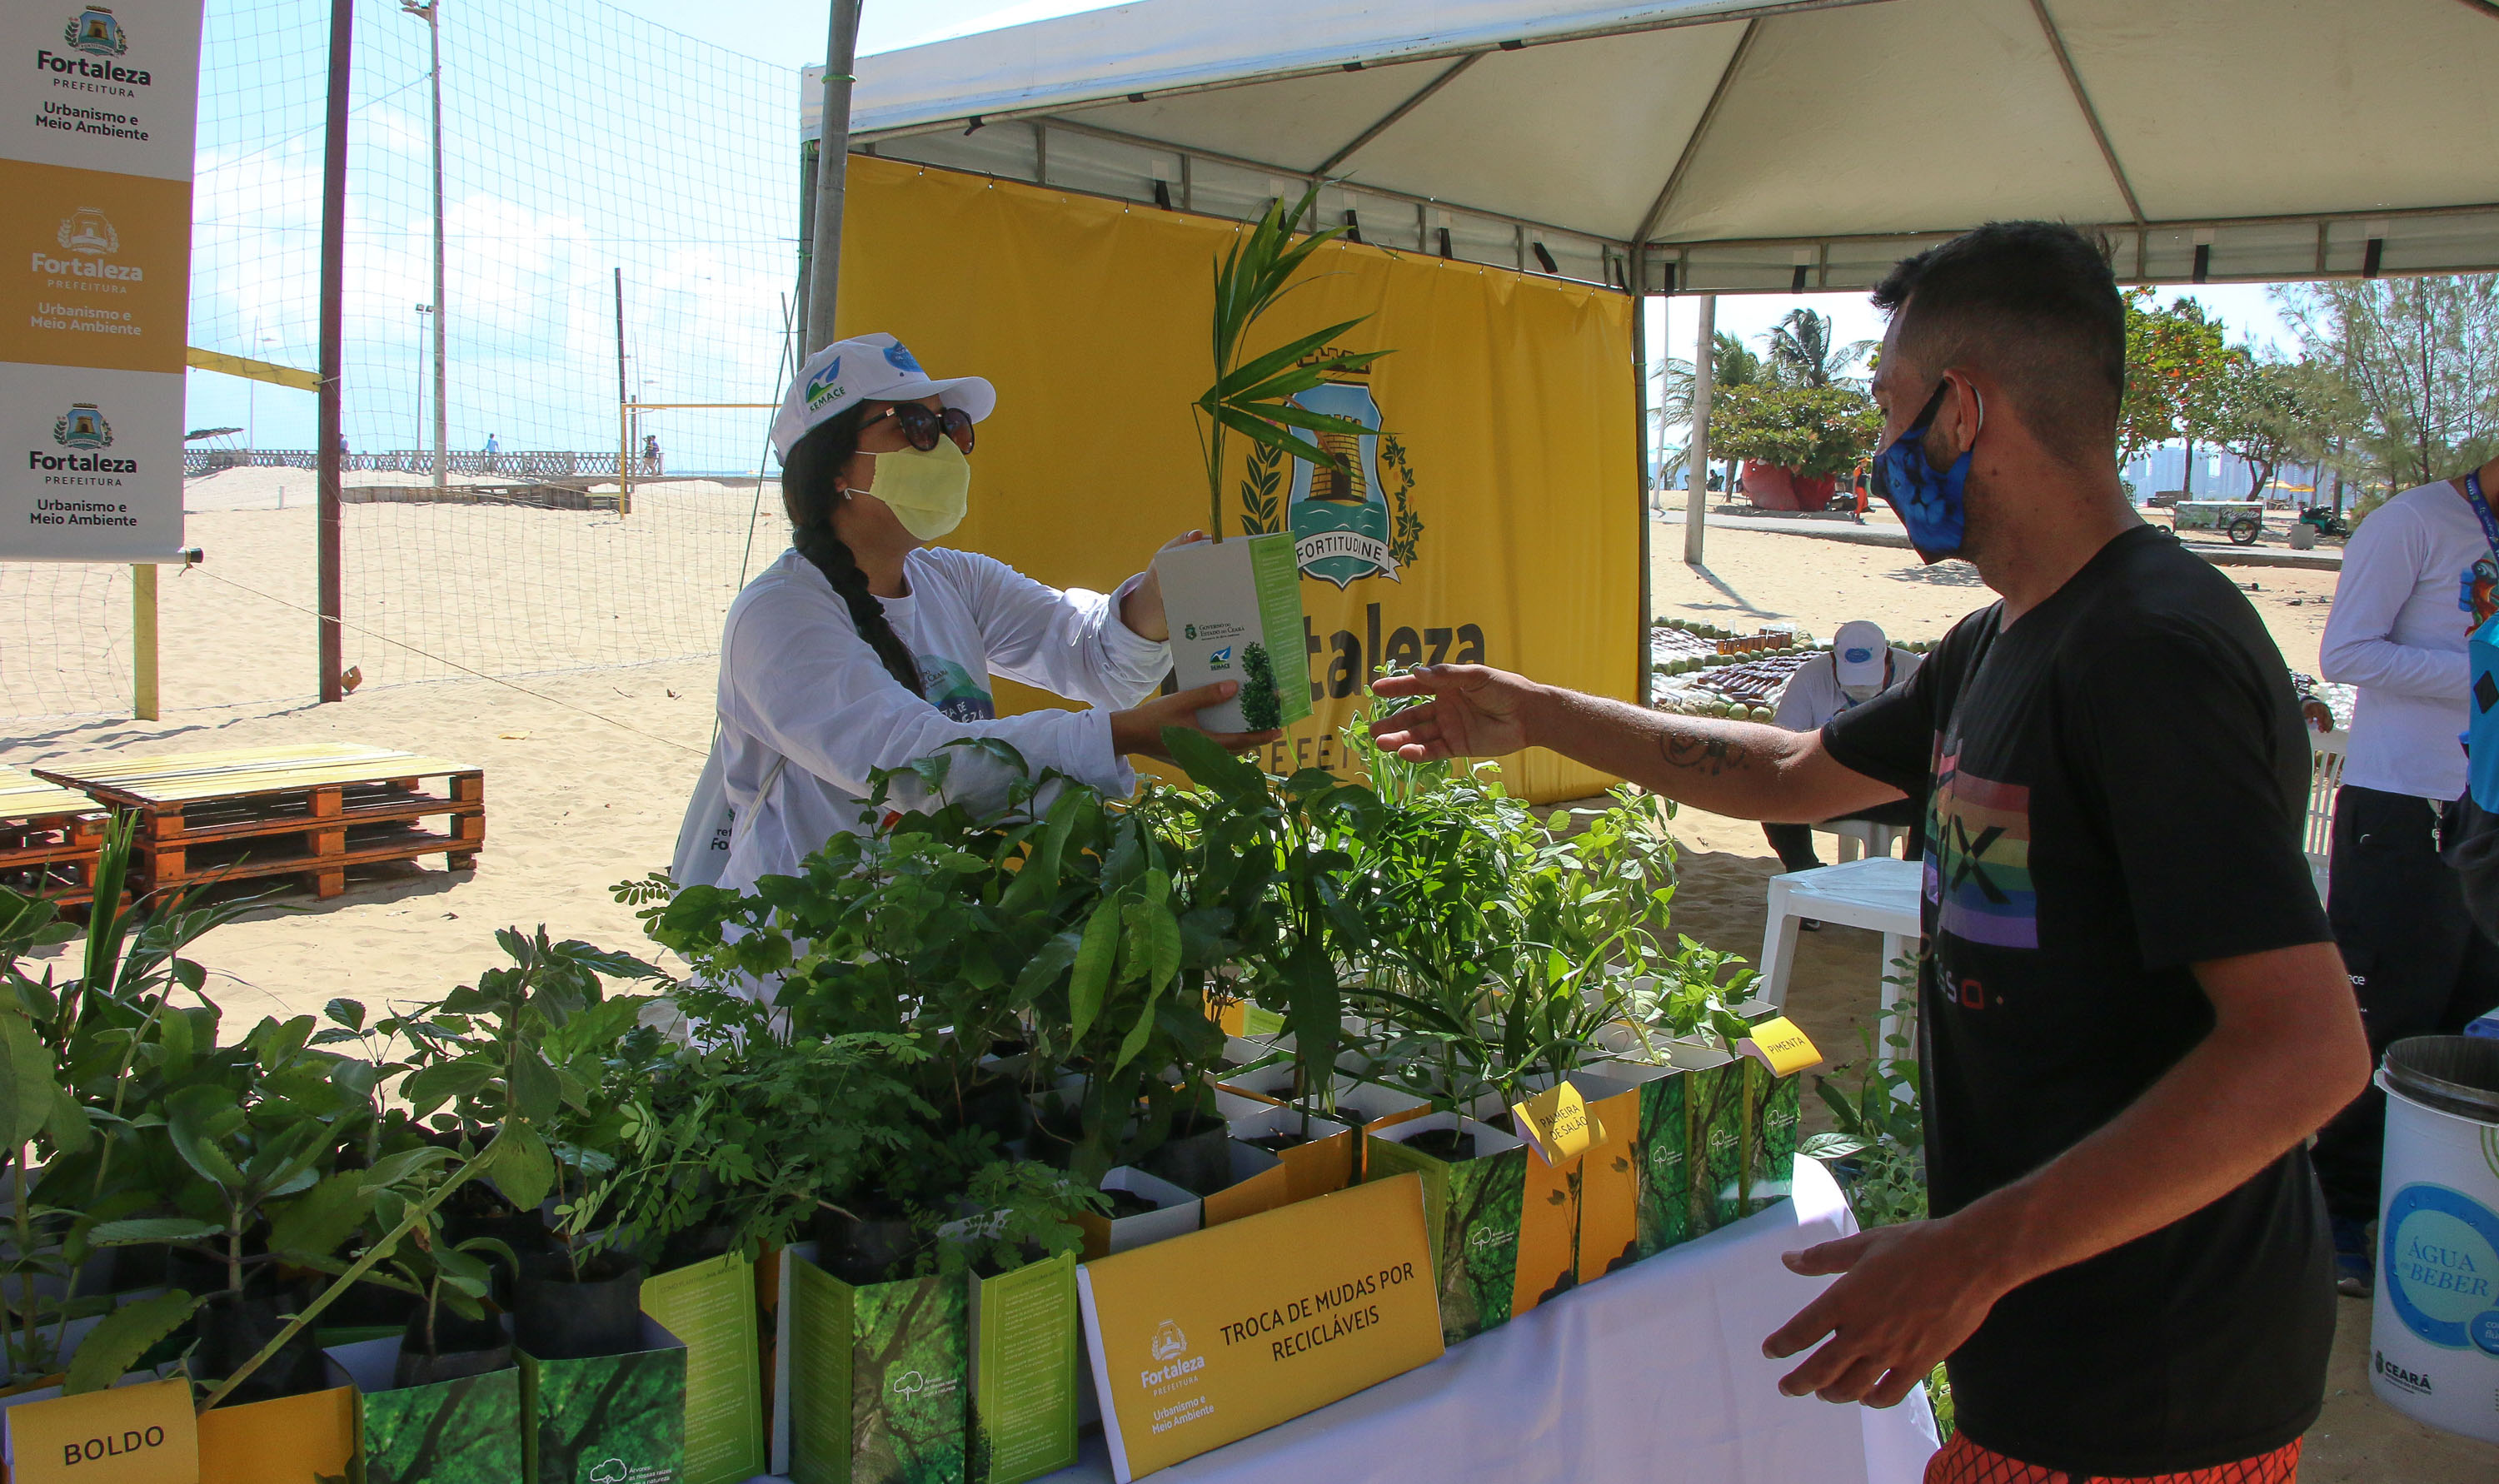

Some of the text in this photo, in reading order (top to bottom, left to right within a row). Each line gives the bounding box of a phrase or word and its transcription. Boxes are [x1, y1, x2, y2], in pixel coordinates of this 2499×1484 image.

[37, 50, 152, 86] Fortaleza
[53, 78, 135, 97] PREFEITURA
[43, 101, 138, 126] Urbanismo e
[35, 114, 149, 142] Meio Ambiente
[32, 252, 143, 281] Fortaleza
[47, 279, 127, 294] PREFEITURA
[39, 301, 132, 321] Urbanismo e
[31, 316, 142, 335] Meio Ambiente
[29, 451, 137, 473] Fortaleza
[45, 476, 122, 486] PREFEITURA
[37, 499, 127, 512] Urbanismo e
[30, 513, 137, 526] Meio Ambiente
[1296, 536, 1383, 563] FORTITUDINE
[1304, 603, 1485, 701] taleza
[1768, 1037, 1805, 1054] PIMENTA
[1539, 1104, 1580, 1128] PALMEIRA
[1549, 1116, 1589, 1141] DE SALÃO
[2407, 1236, 2476, 1272] ÁGUA
[2409, 1263, 2489, 1297] BEBER
[1220, 1262, 1414, 1346] TROCA DE MUDAS POR
[1272, 1305, 1379, 1362] RECICLÁVEIS
[1141, 1356, 1205, 1388] Fortaleza
[2386, 1361, 2432, 1390] CEARÁ
[1153, 1375, 1199, 1397] PREFEITURA
[1152, 1405, 1215, 1434] Meio Ambiente
[1153, 1395, 1205, 1421] Urbanismo e
[64, 1426, 165, 1466] BOLDO
